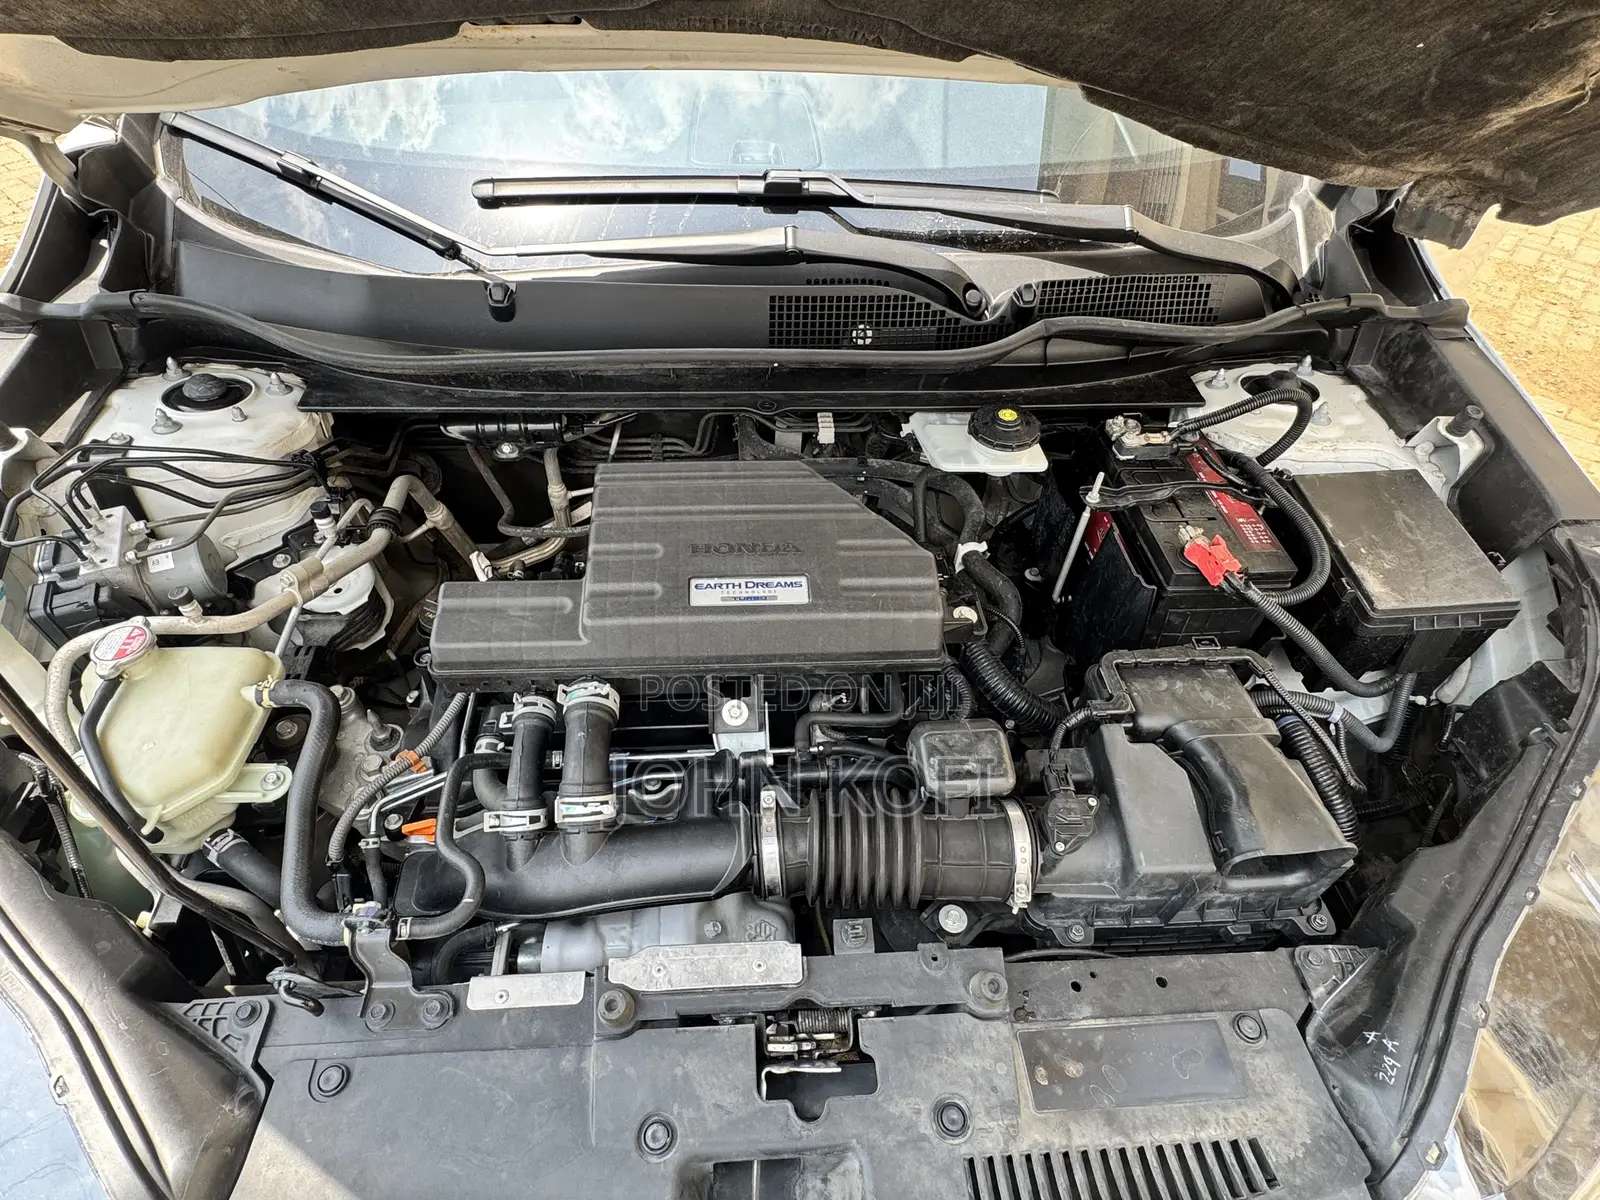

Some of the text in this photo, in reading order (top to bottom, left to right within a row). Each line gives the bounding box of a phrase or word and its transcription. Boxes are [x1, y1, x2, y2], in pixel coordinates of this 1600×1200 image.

[689, 542, 803, 556] HONDA
[694, 580, 803, 590] EARTH DREAMS
